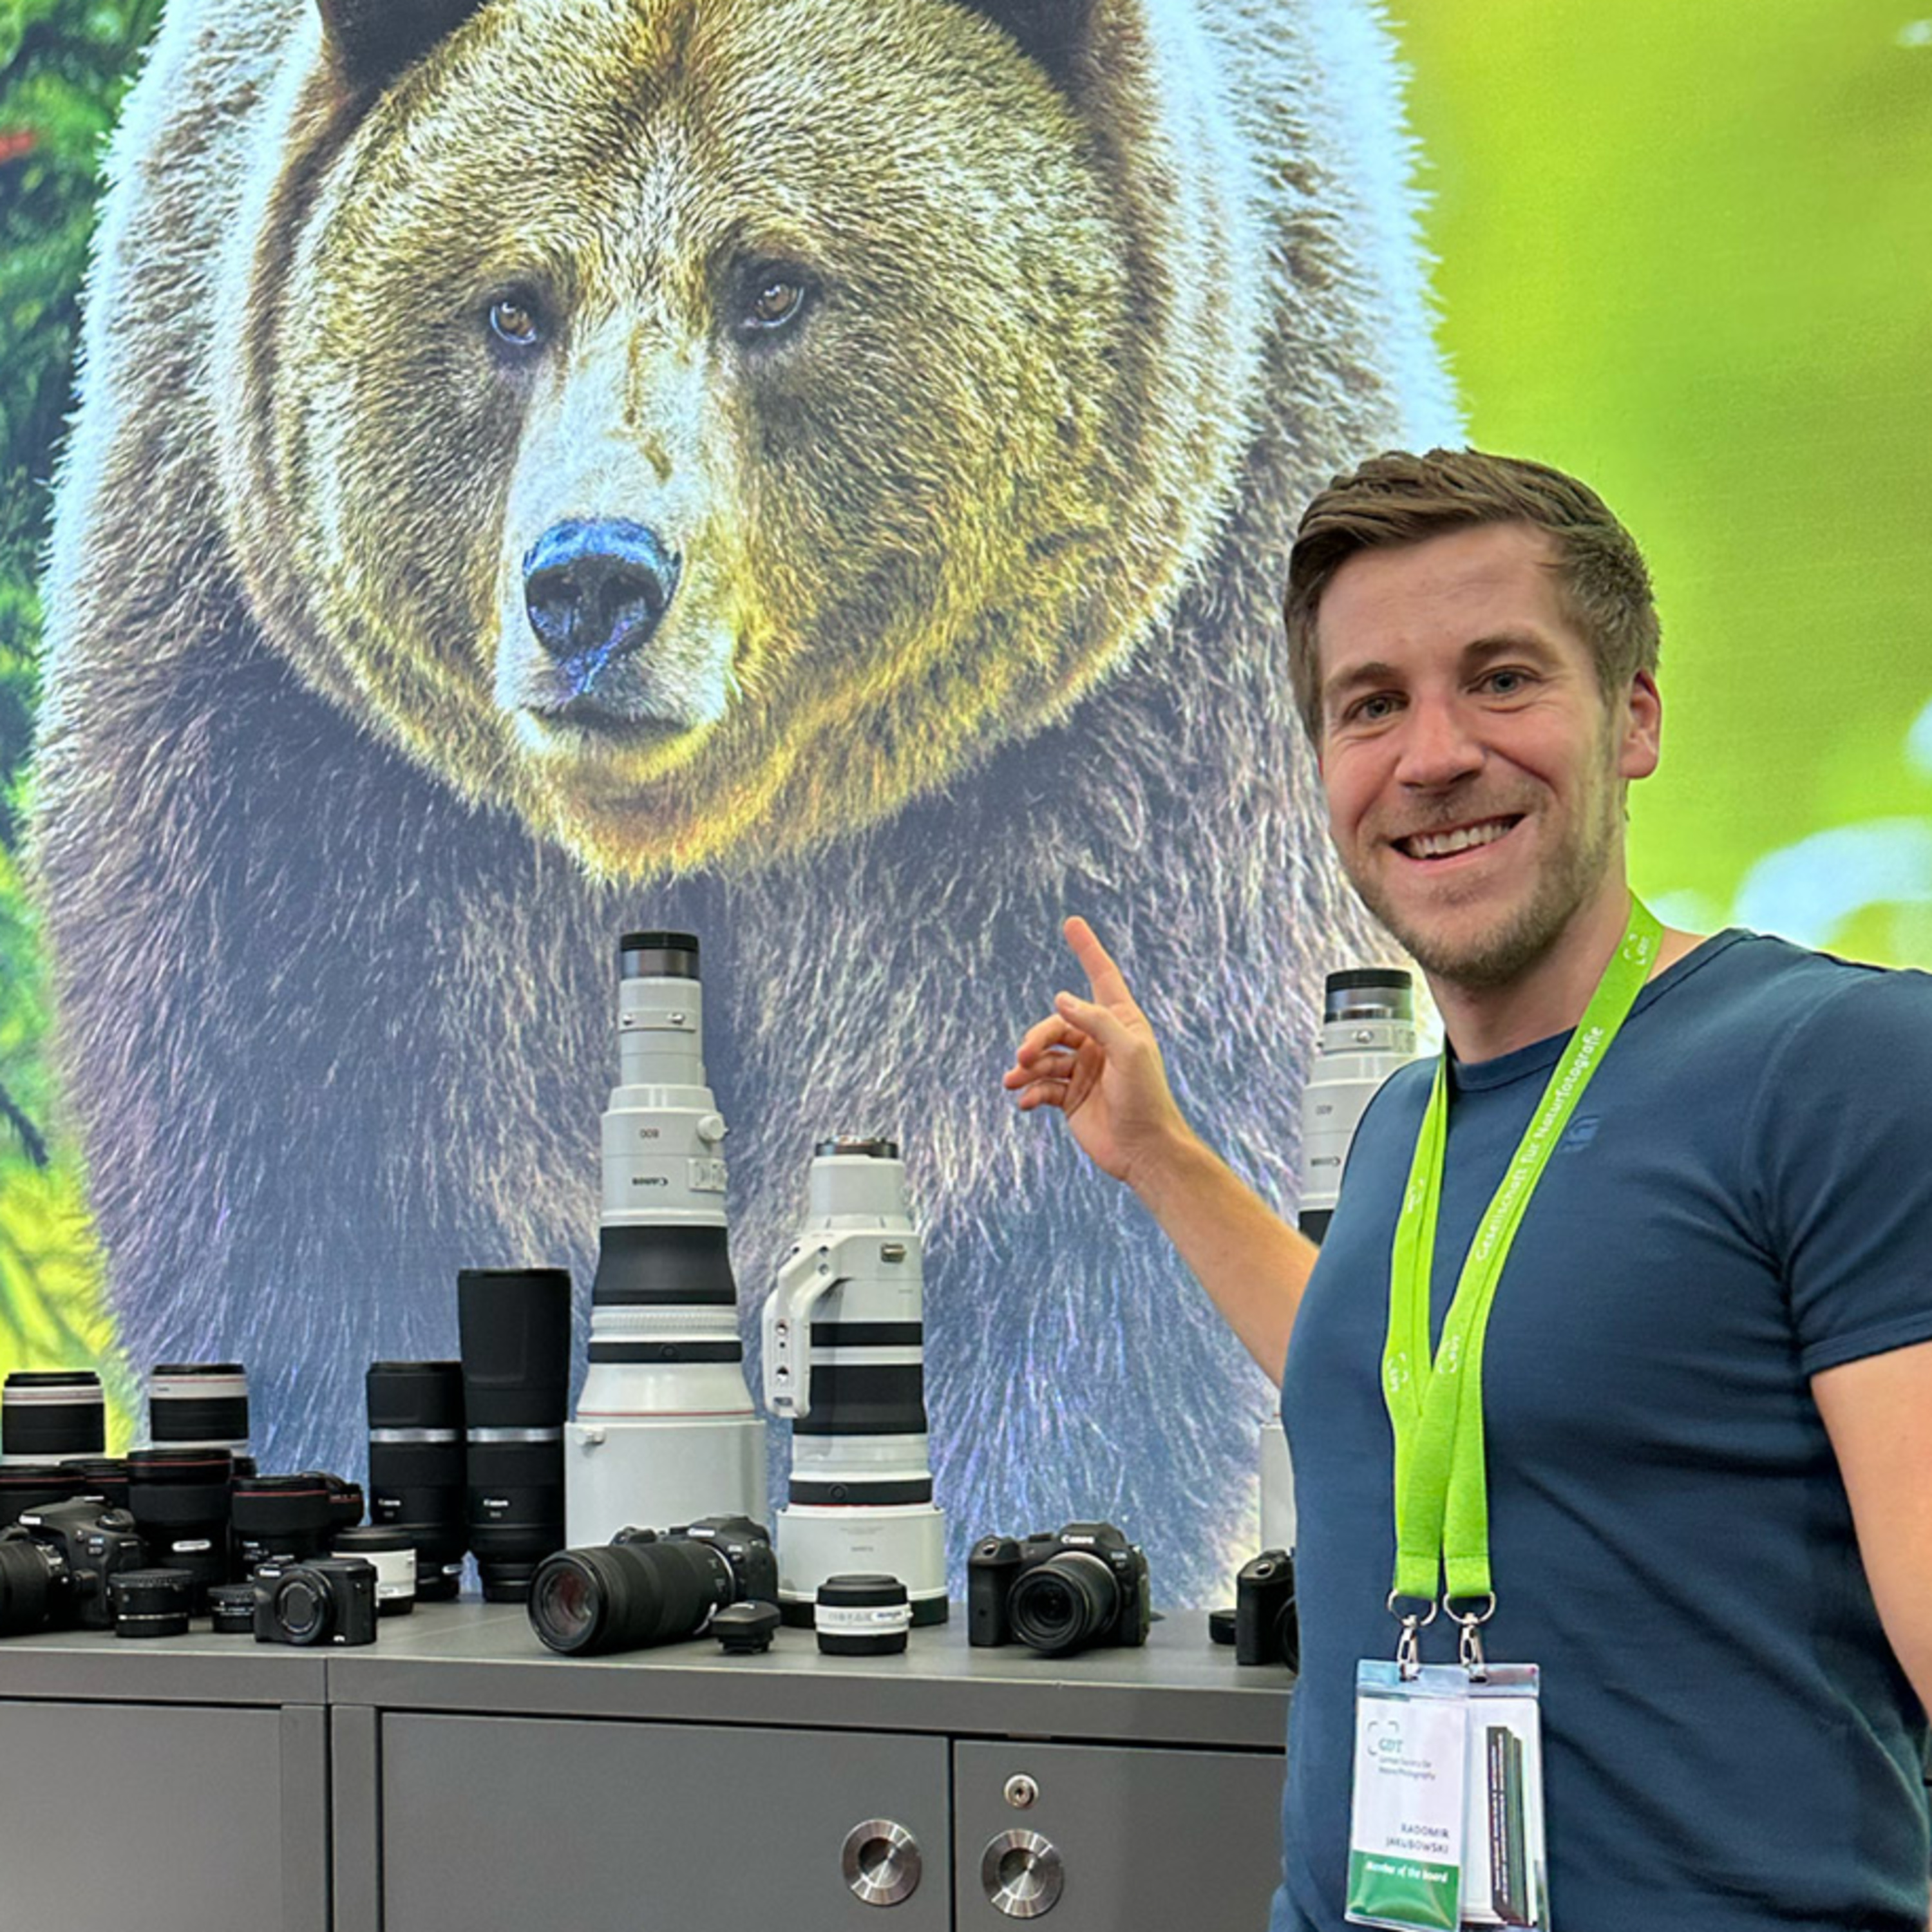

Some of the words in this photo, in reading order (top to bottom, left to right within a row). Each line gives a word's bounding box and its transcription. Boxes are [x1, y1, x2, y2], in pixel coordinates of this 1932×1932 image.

[1475, 1166, 1528, 1261] Gesellschaft
[1533, 1025, 1604, 1141] Naturfotografie
[1061, 1534, 1095, 1544] Canon
[1401, 1823, 1449, 1838] RADOMIR
[1387, 1837, 1448, 1853] JAKUBOWSKI
